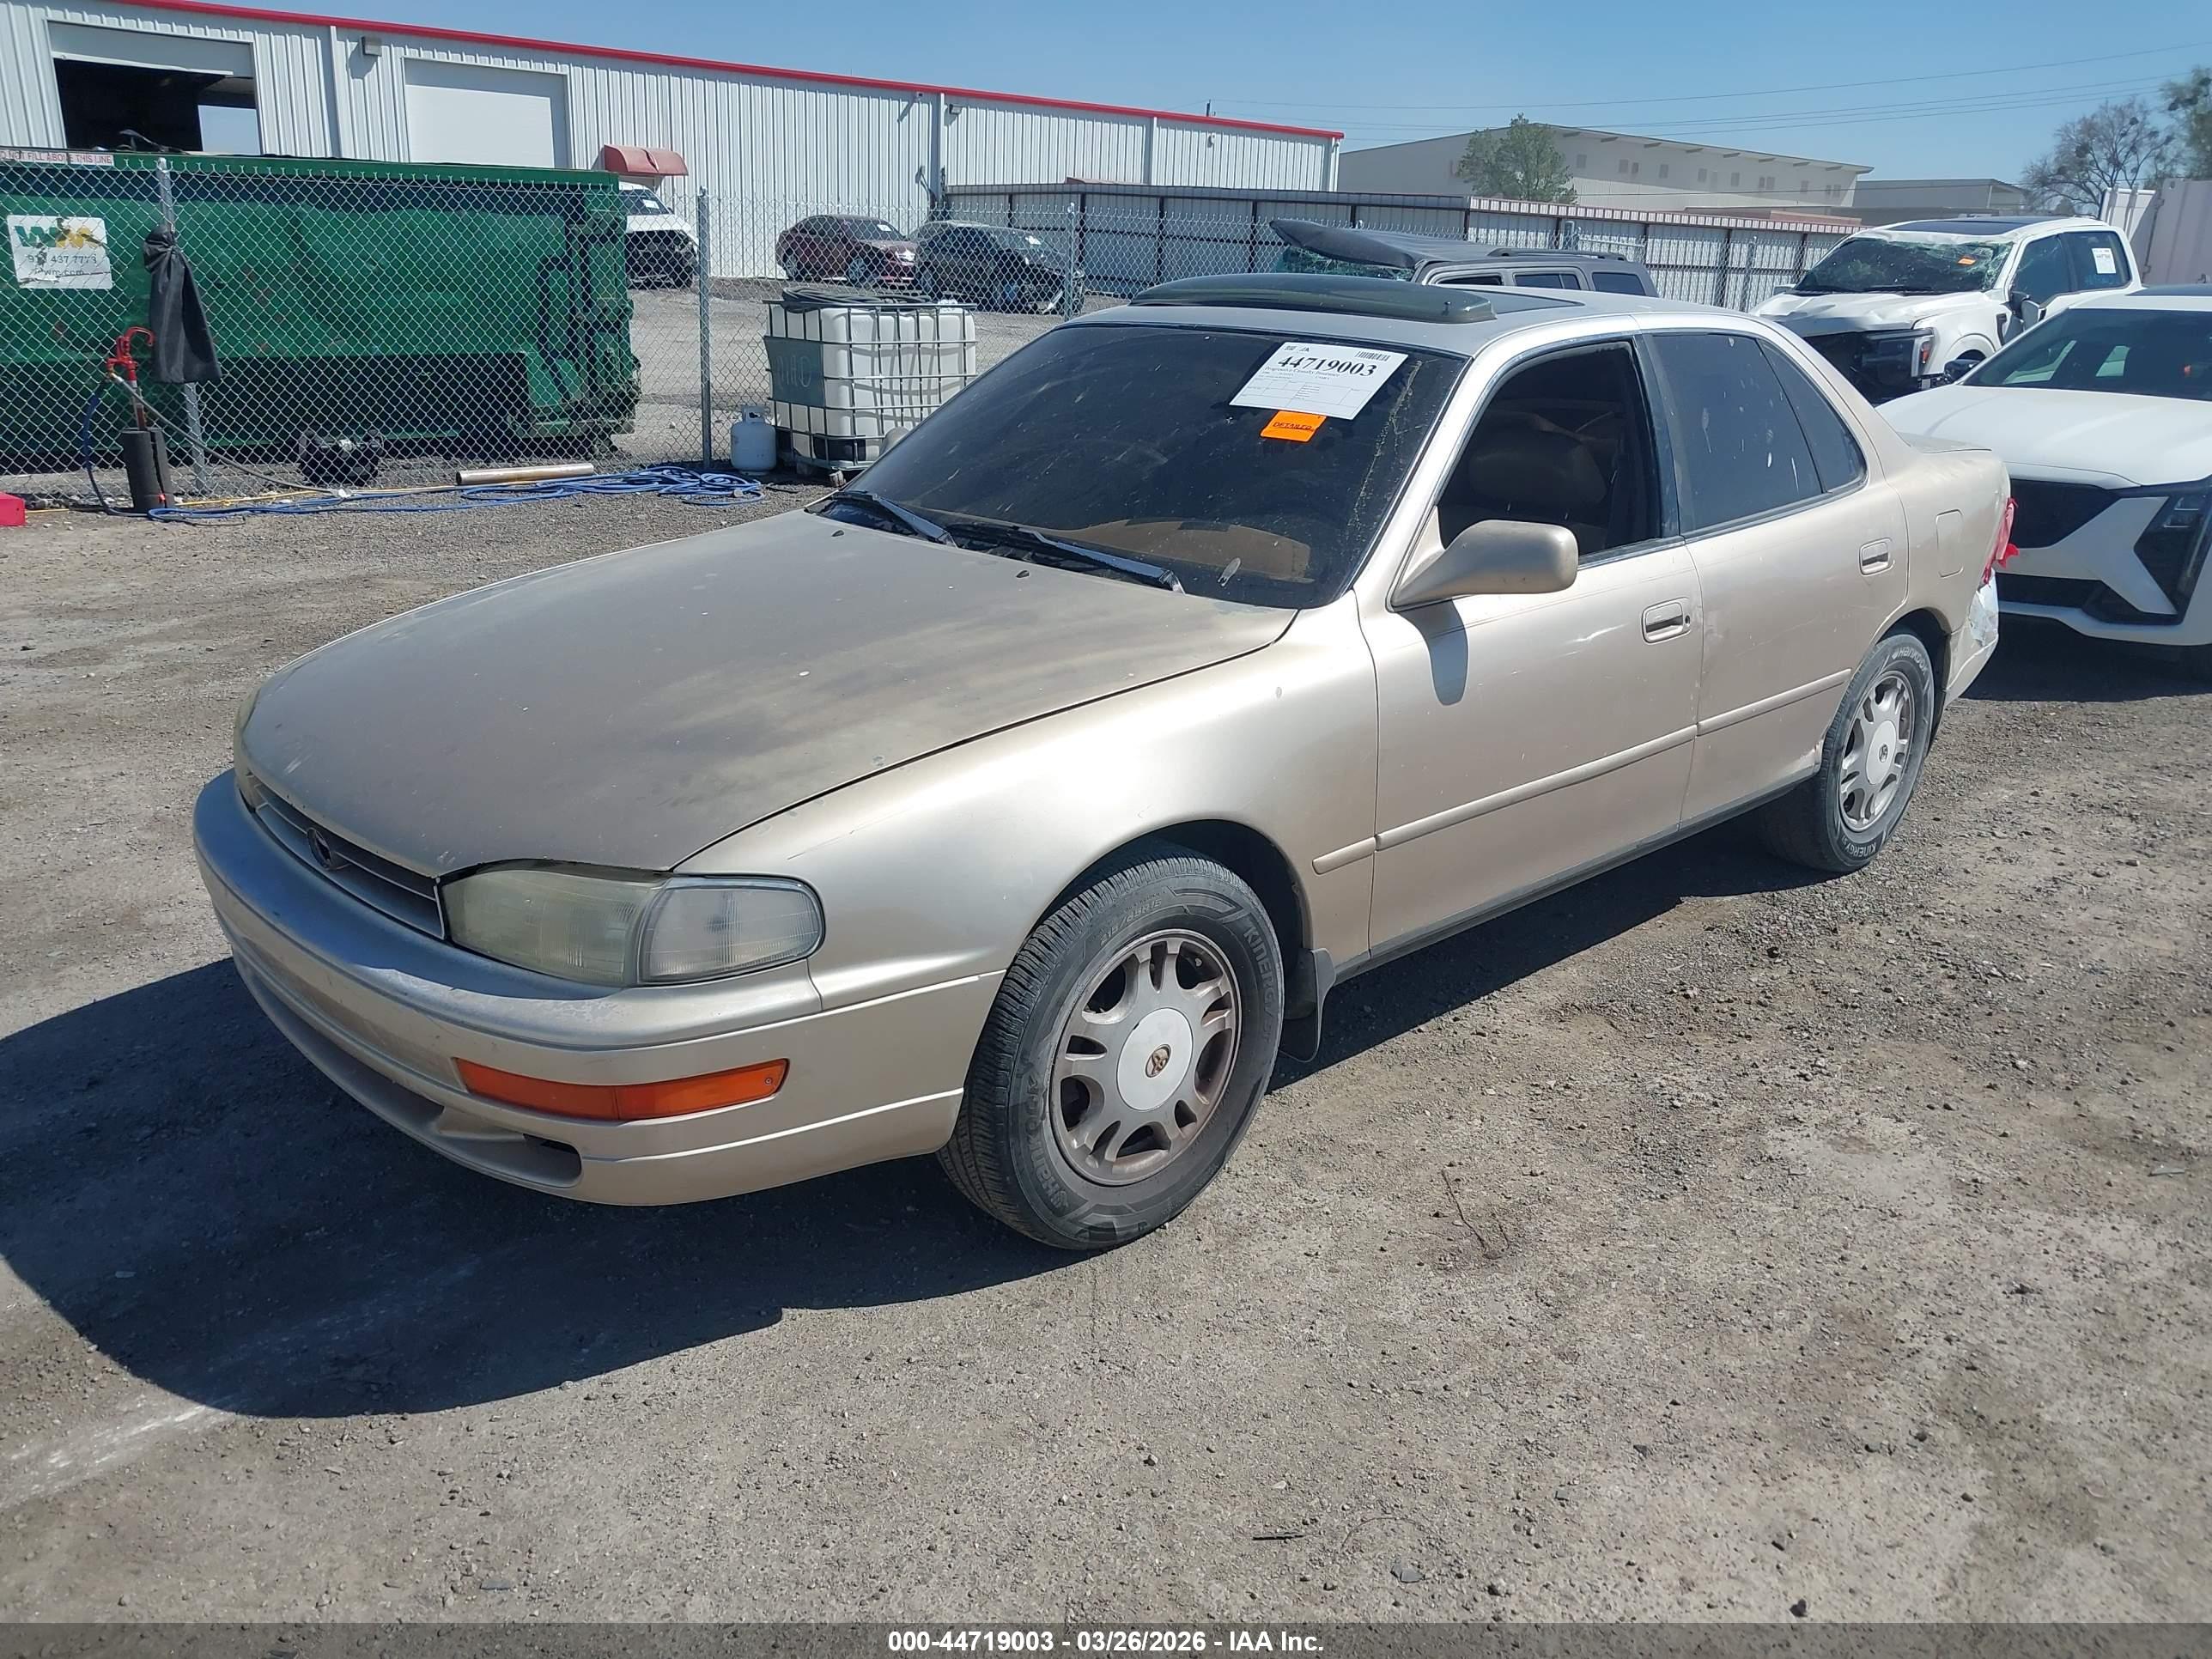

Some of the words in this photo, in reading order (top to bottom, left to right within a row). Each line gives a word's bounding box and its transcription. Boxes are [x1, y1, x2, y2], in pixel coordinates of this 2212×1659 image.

[76, 155, 94, 163] THIS
[94, 155, 112, 164] LINE
[51, 255, 70, 264] 437
[1278, 356, 1377, 377] 44719003
